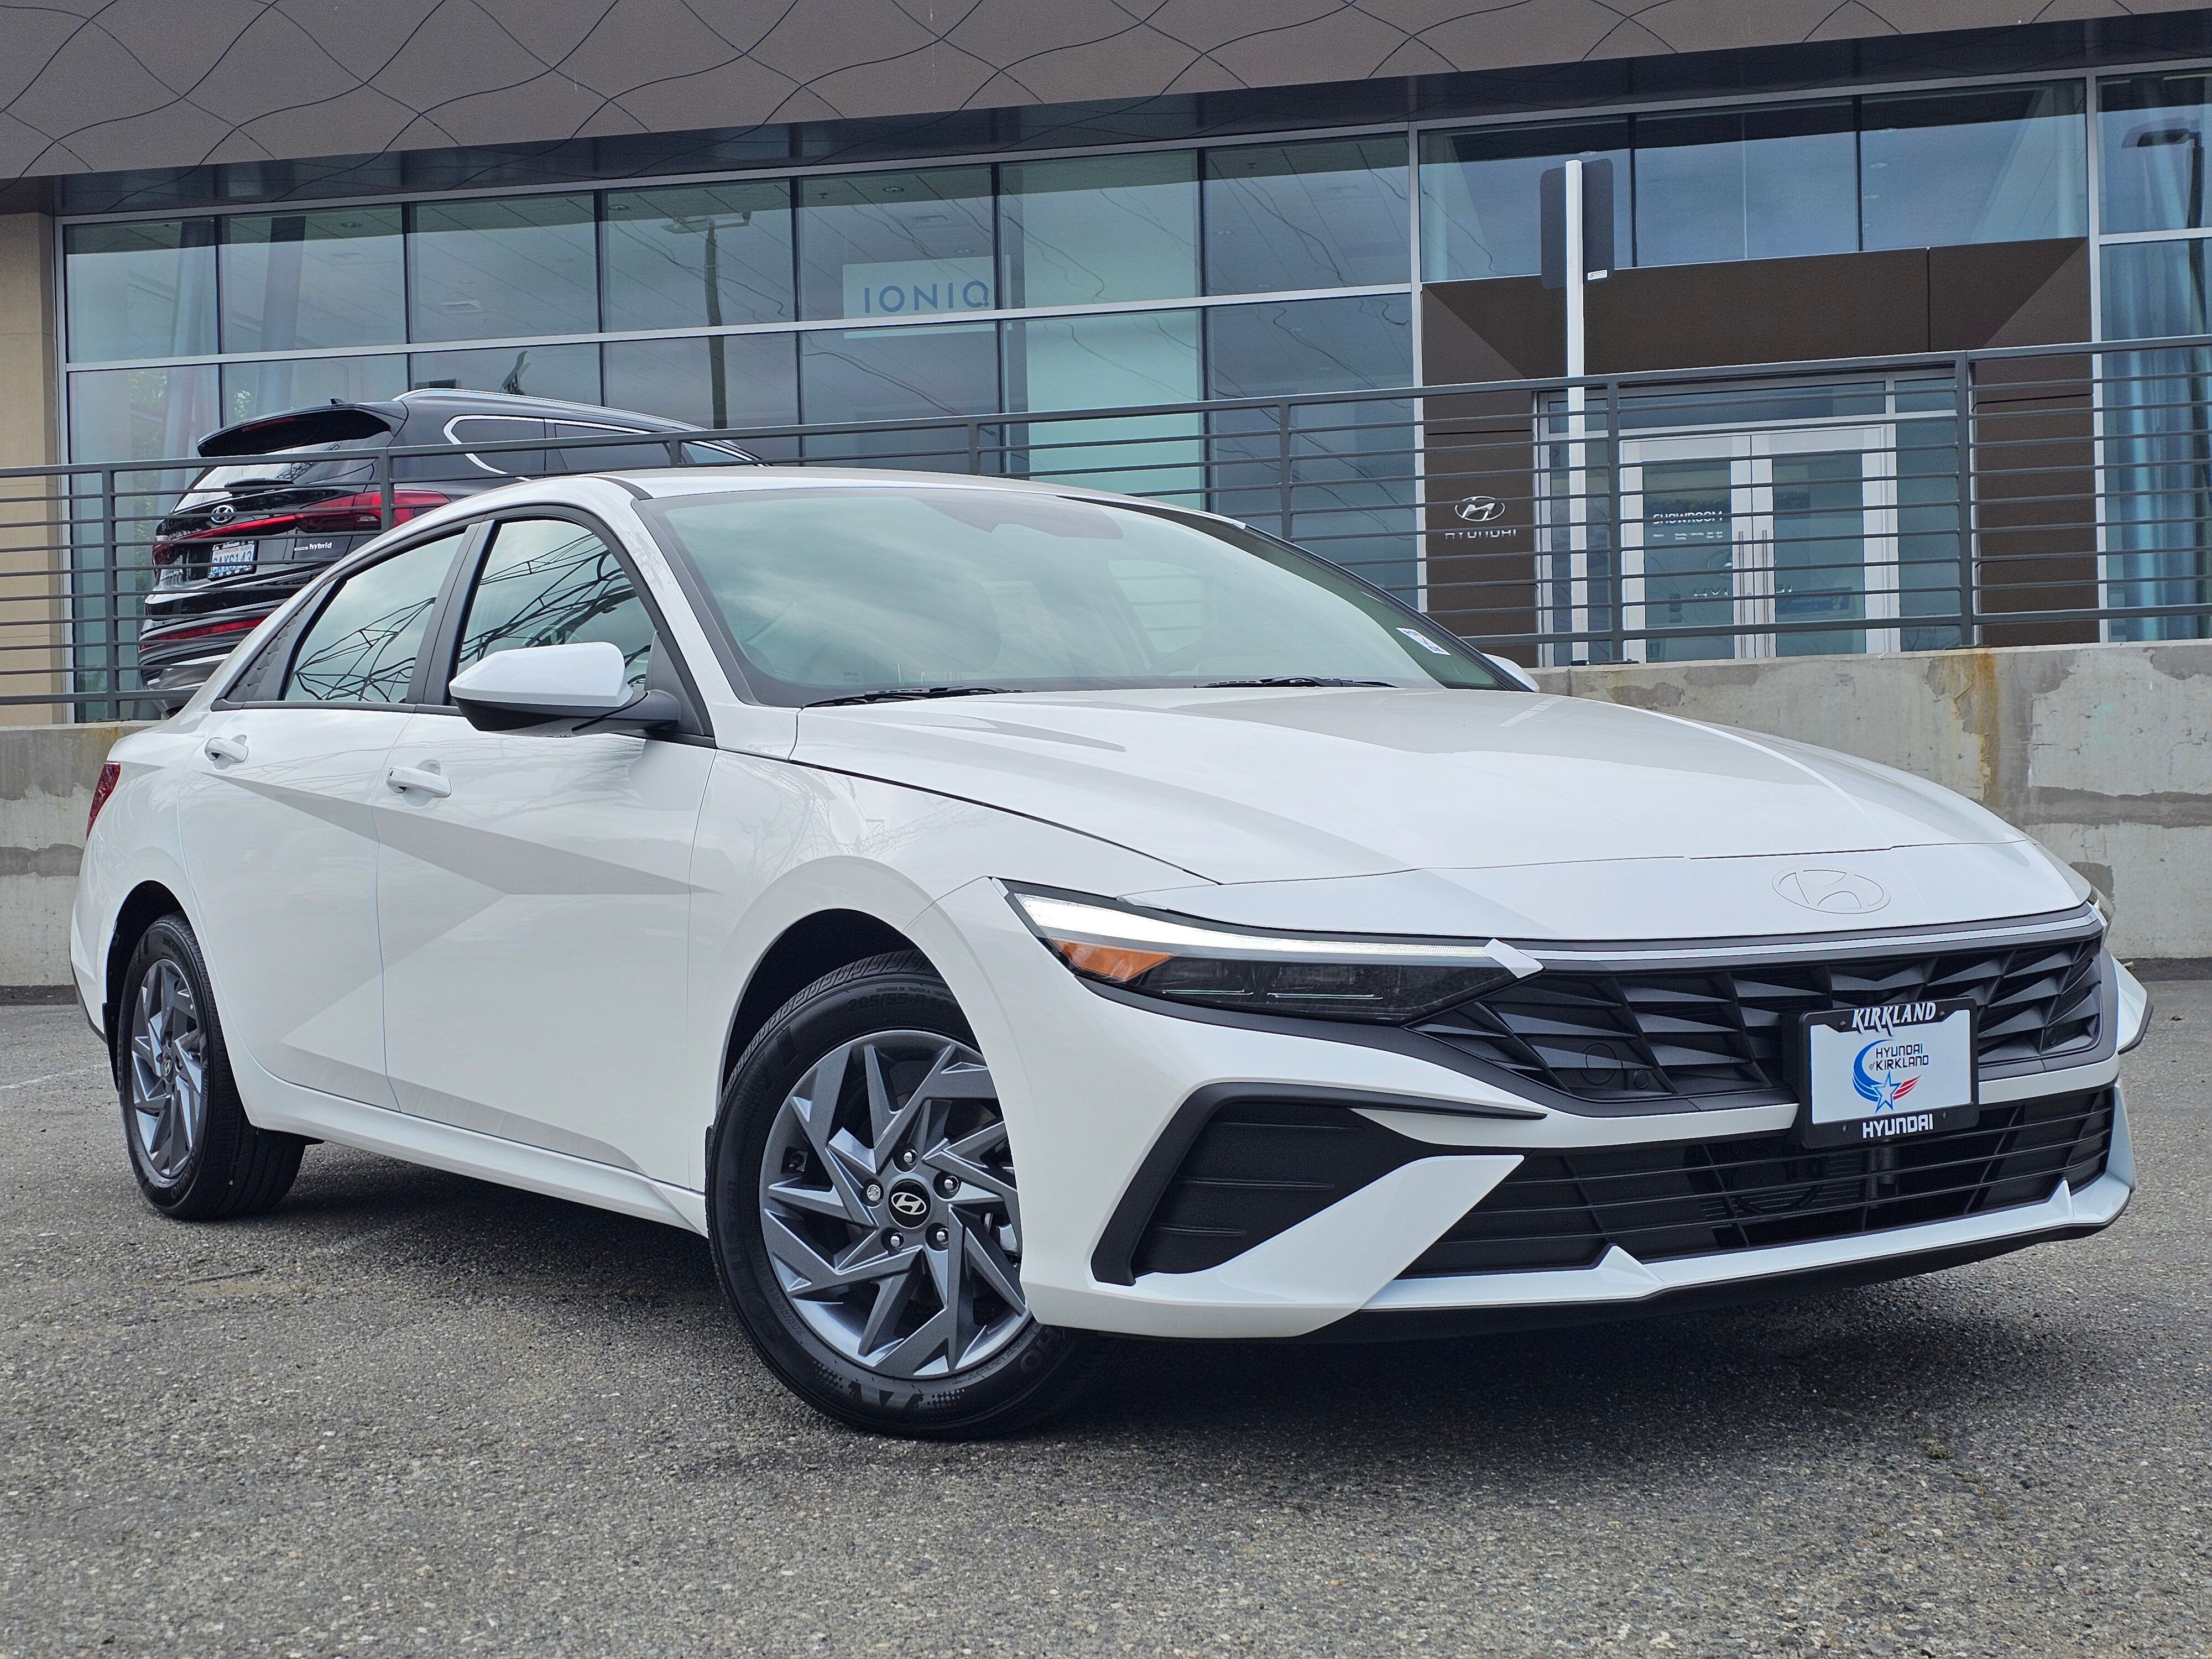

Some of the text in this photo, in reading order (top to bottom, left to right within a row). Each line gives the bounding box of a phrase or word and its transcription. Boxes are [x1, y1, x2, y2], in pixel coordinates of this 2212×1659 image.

[864, 280, 990, 313] IONIQ
[1653, 511, 1723, 524] SHOWROOM
[310, 542, 332, 551] hybrid
[1851, 1001, 1936, 1036] KIRKLAND
[1876, 1043, 1923, 1058] HYUNDAI
[1869, 1055, 1929, 1071] of KIRKLAND
[1862, 1113, 1933, 1139] HYUNDAI
